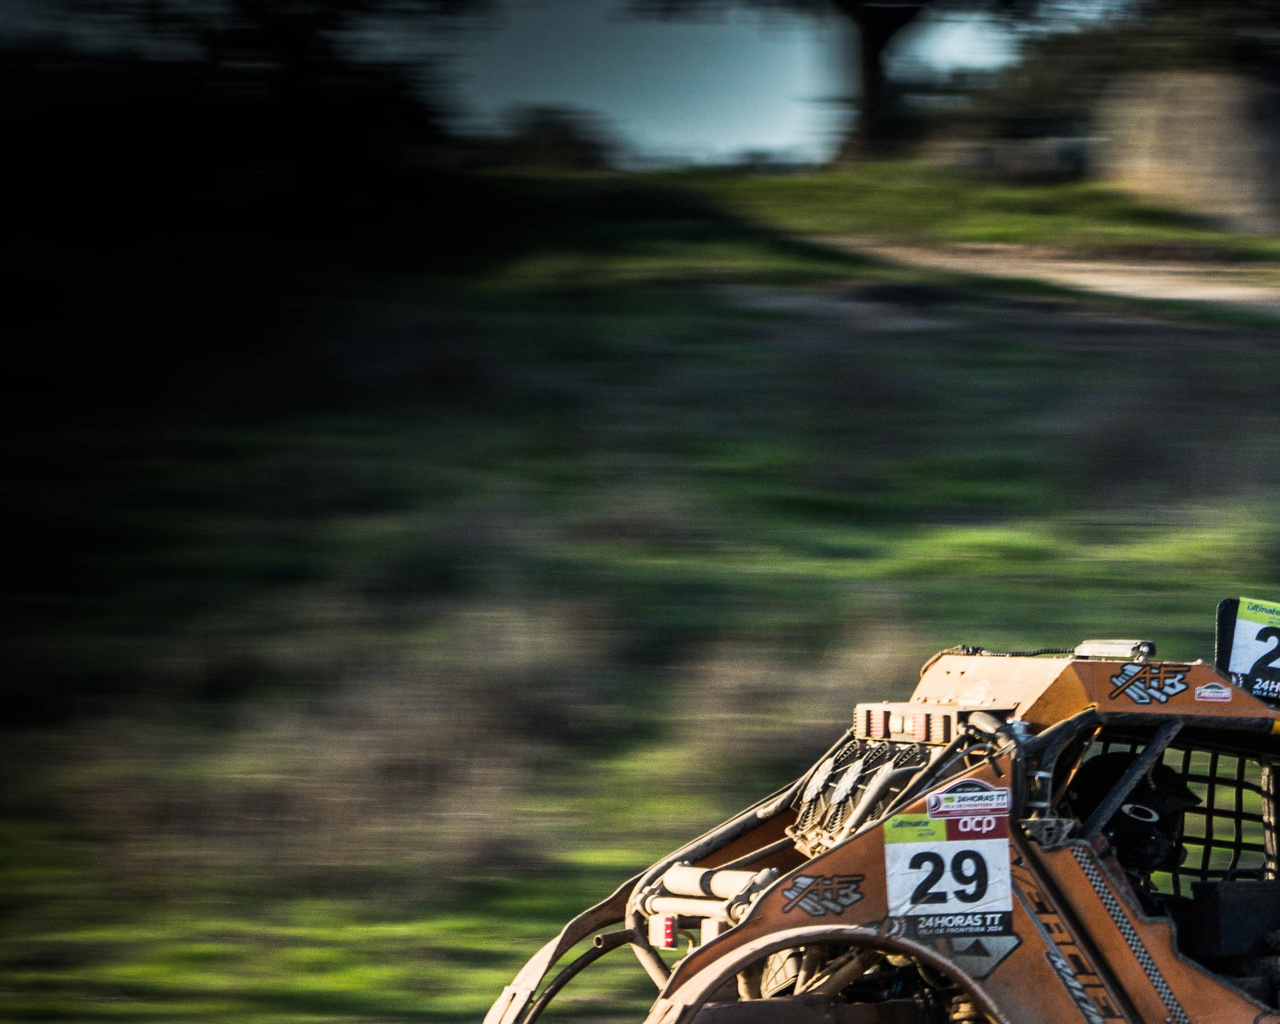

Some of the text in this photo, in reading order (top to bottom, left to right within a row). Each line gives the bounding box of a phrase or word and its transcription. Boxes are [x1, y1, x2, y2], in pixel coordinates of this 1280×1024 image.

[958, 817, 996, 834] acp
[908, 849, 989, 905] 29
[984, 913, 1003, 926] TT
